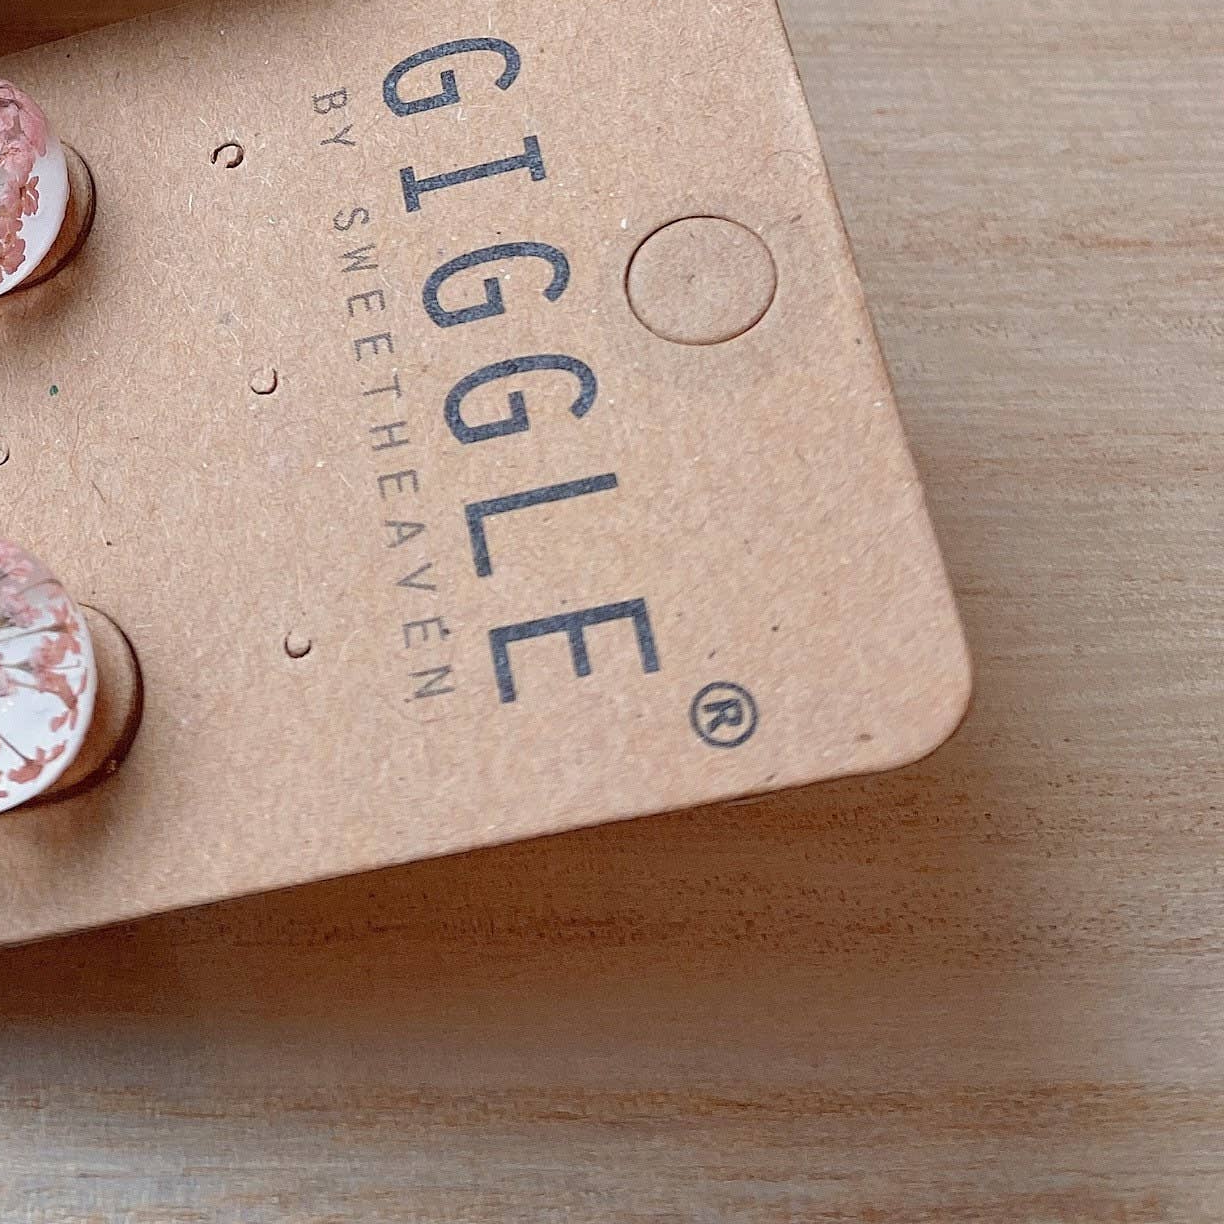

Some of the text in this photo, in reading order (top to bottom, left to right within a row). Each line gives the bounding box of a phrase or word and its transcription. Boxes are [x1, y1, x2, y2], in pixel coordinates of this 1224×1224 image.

[311, 86, 455, 704] BY SWEETHEAVEN
[381, 36, 660, 704] GIGGLE
